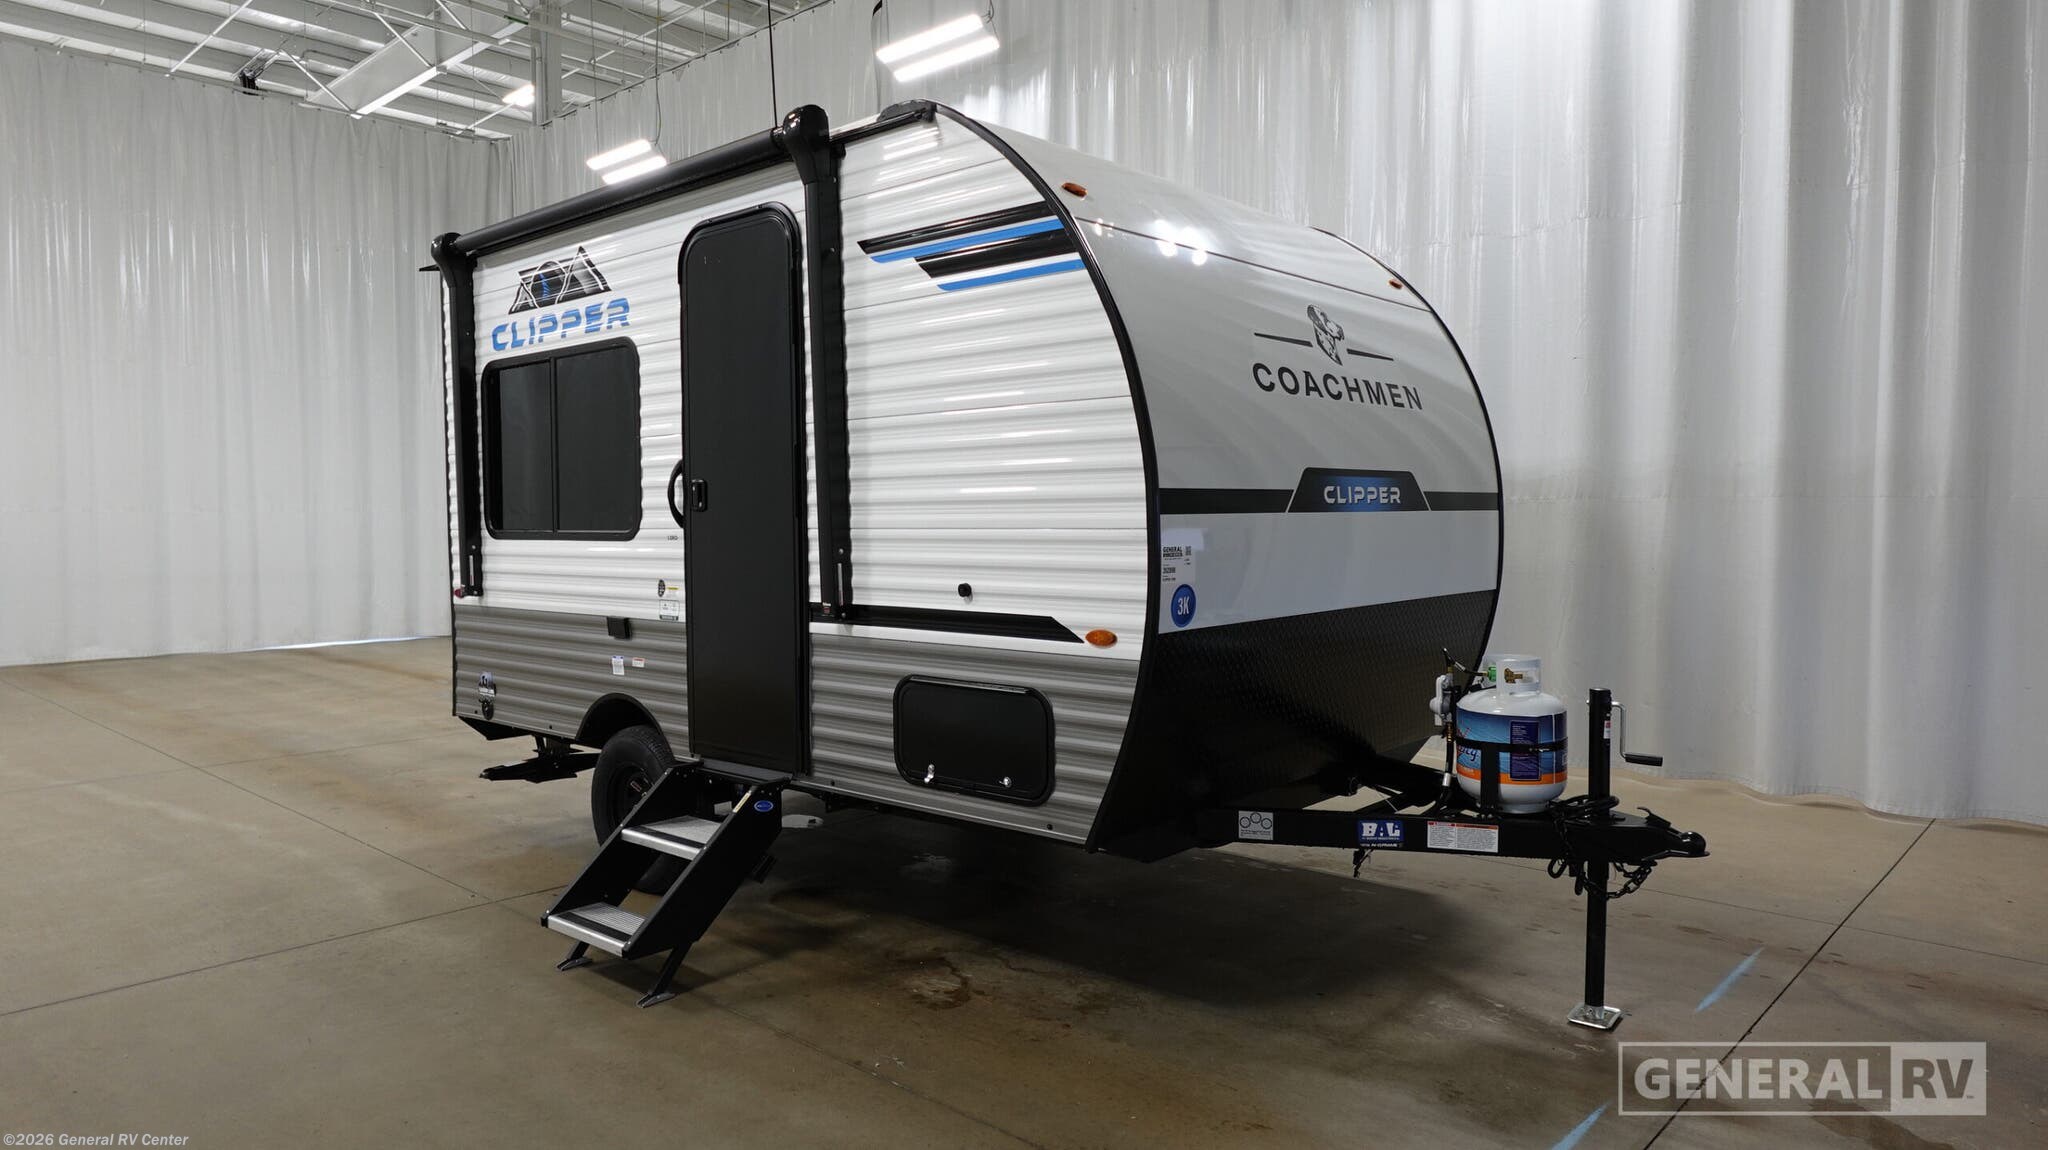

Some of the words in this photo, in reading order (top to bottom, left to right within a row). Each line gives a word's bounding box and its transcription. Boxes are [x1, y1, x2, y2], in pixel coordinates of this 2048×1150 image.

[491, 297, 630, 351] CLIPPER
[1252, 362, 1423, 410] COACHMEN
[1323, 485, 1401, 504] CLIPPER
[1177, 596, 1190, 615] 3K
